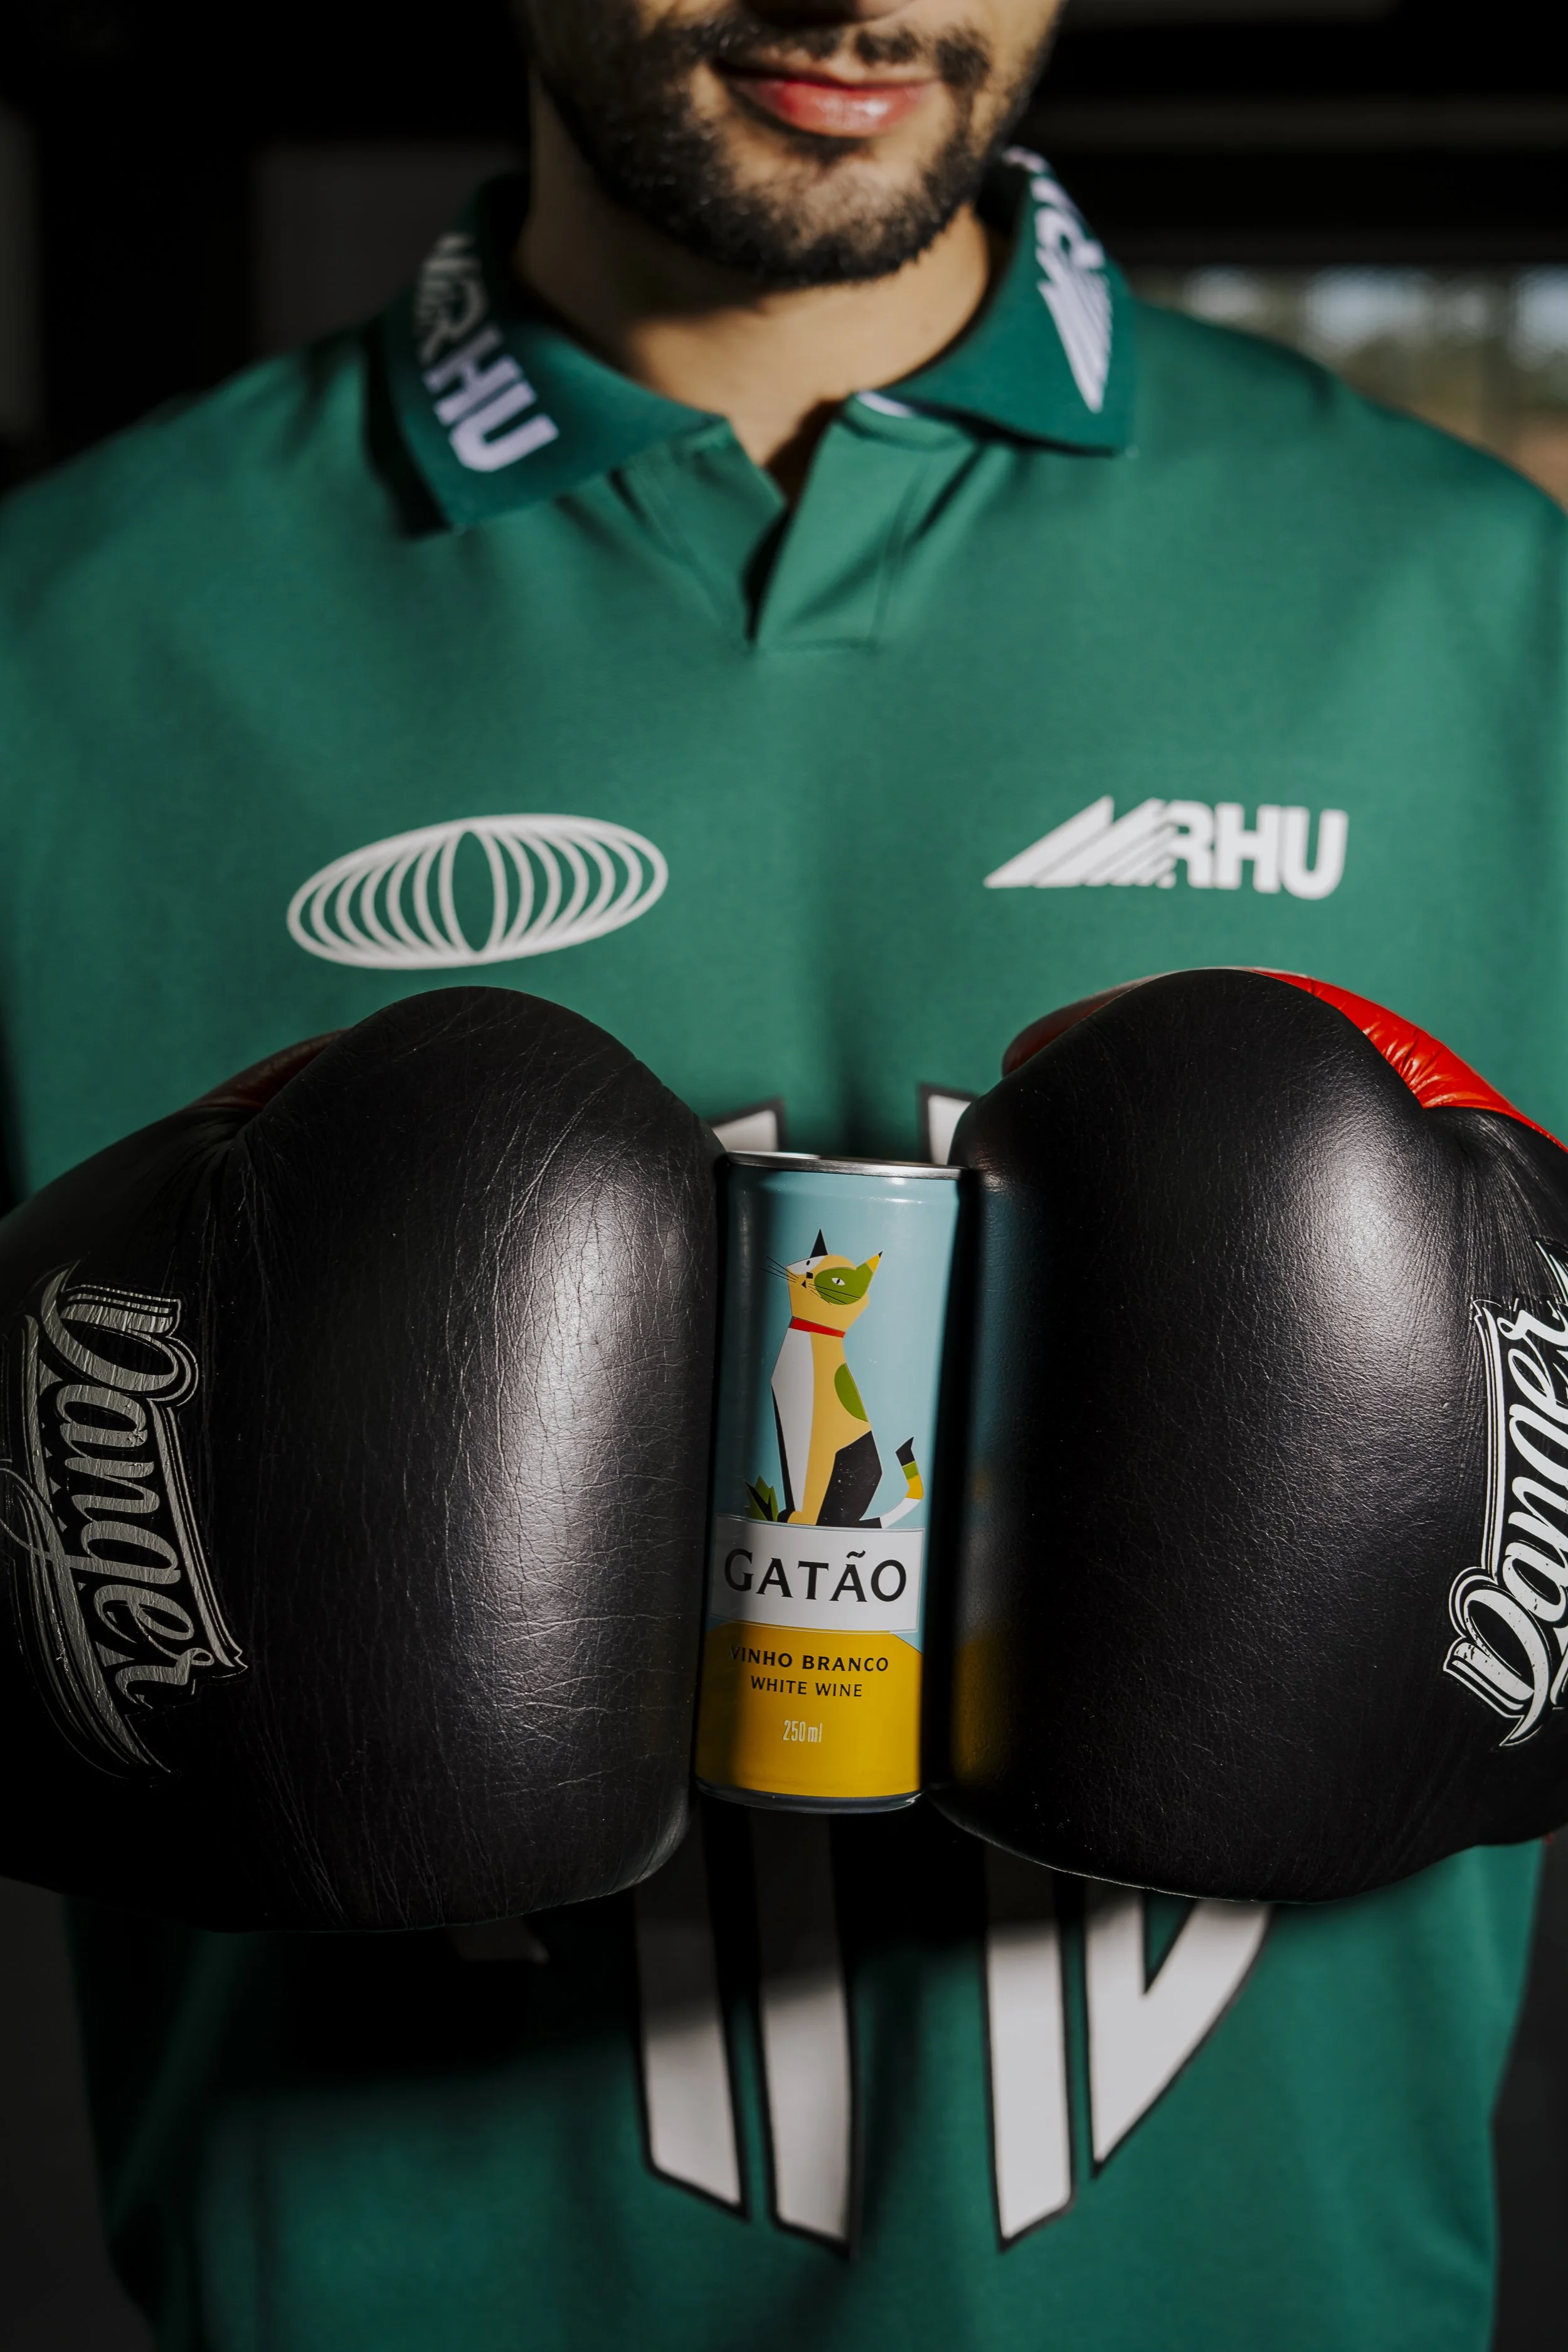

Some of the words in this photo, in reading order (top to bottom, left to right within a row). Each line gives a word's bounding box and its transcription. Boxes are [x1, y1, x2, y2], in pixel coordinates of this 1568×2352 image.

[0, 1266, 220, 1722] Danger
[724, 1547, 907, 1602] GATÃO
[730, 1645, 793, 1668] VINHO
[802, 1655, 889, 1672] BRANCO
[750, 1675, 807, 1695] WHITE
[815, 1682, 862, 1697] WINE
